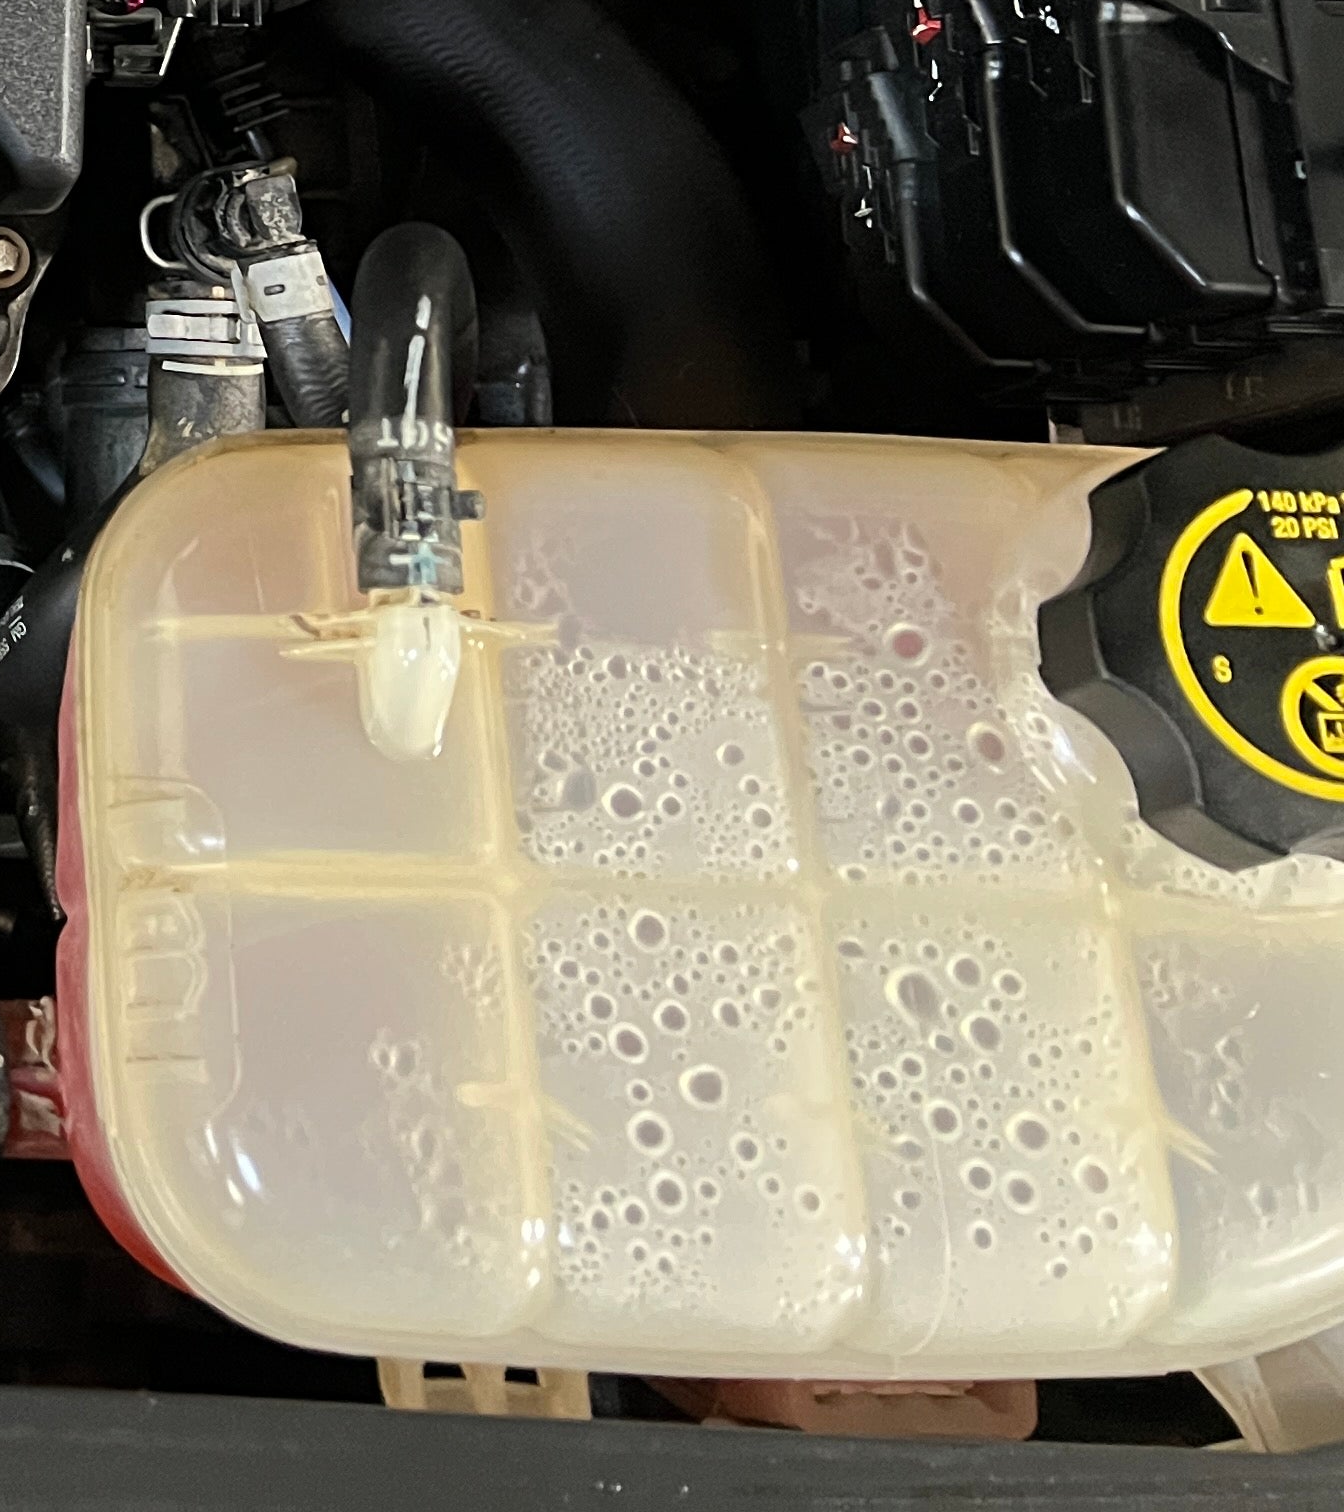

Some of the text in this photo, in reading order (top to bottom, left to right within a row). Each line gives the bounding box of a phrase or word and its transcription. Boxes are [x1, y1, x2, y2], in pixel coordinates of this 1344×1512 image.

[1257, 490, 1341, 515] 140 kPa
[1271, 515, 1339, 539] 20 PSI
[1213, 654, 1233, 684] S
